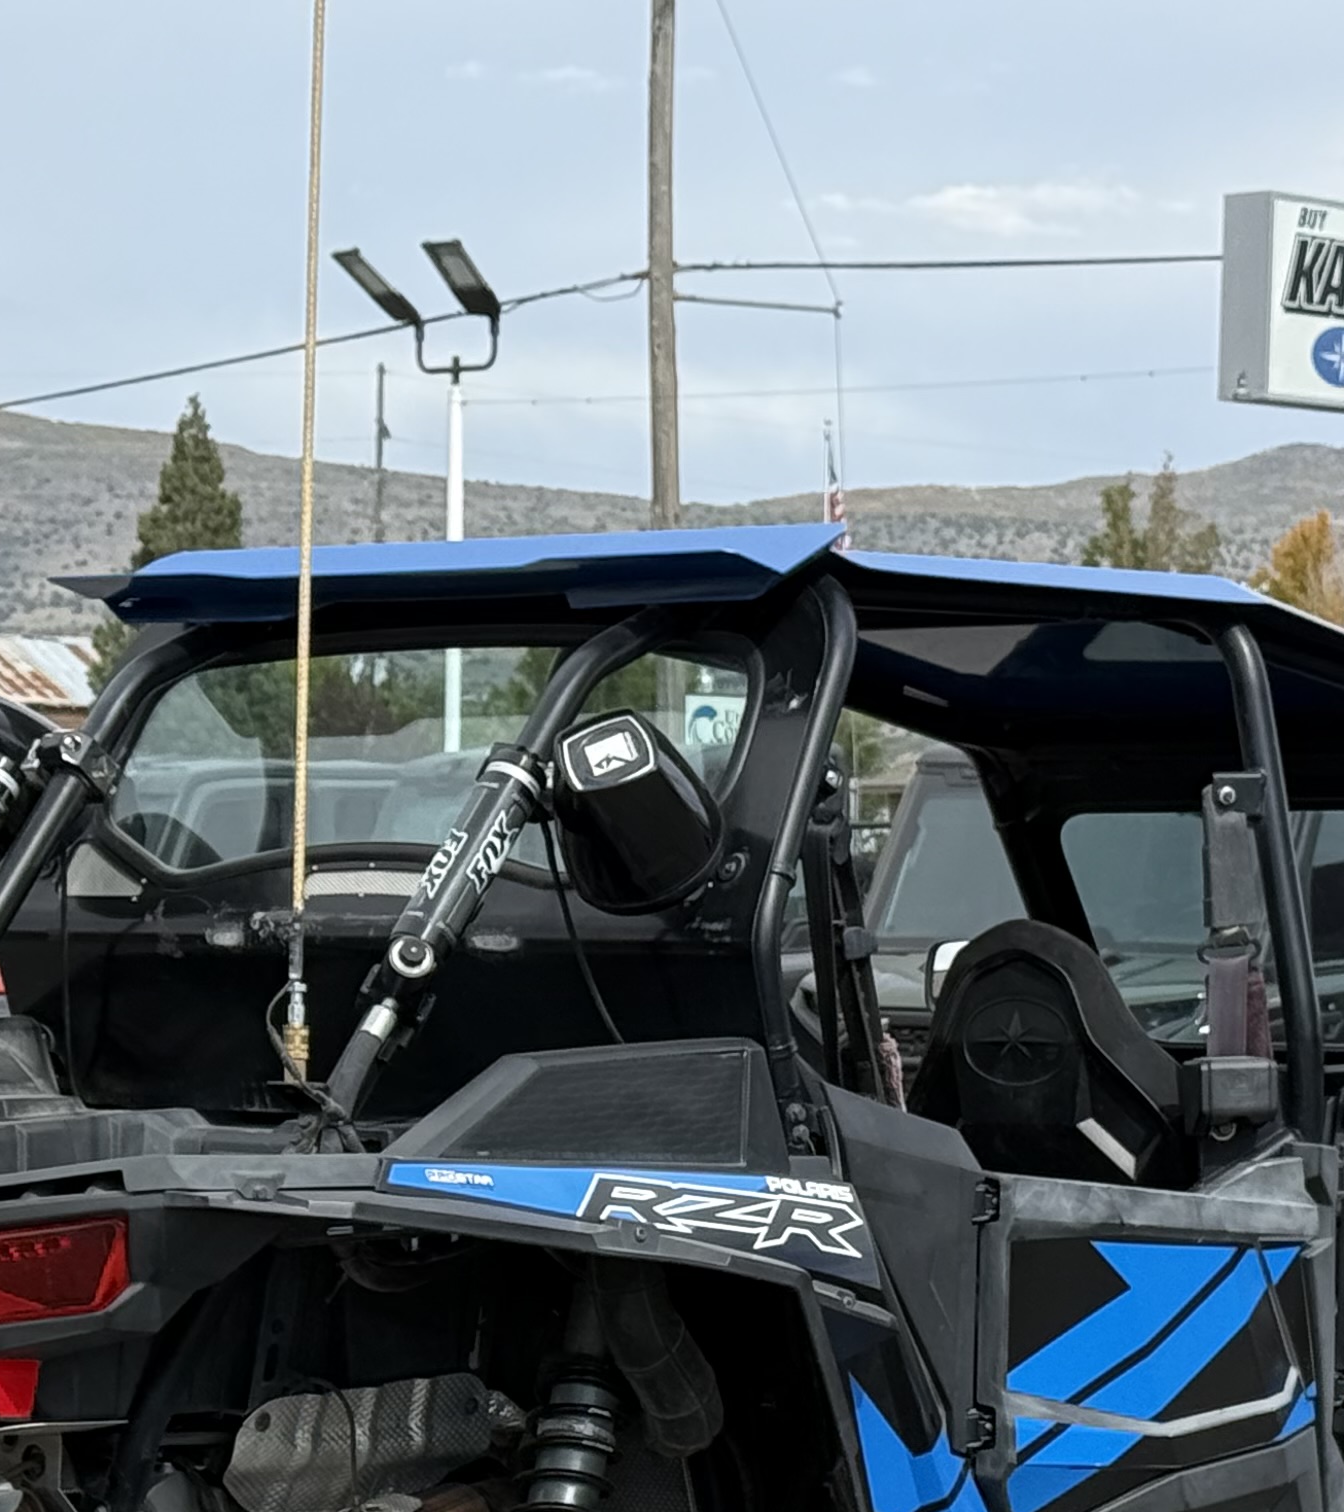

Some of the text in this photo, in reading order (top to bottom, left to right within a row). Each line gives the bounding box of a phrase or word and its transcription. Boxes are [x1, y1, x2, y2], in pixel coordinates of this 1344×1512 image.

[1298, 207, 1327, 229] BUY
[420, 827, 469, 899] FOX
[465, 809, 518, 894] FOX
[576, 1173, 863, 1258] RZR
[765, 1175, 854, 1202] POLARIS
